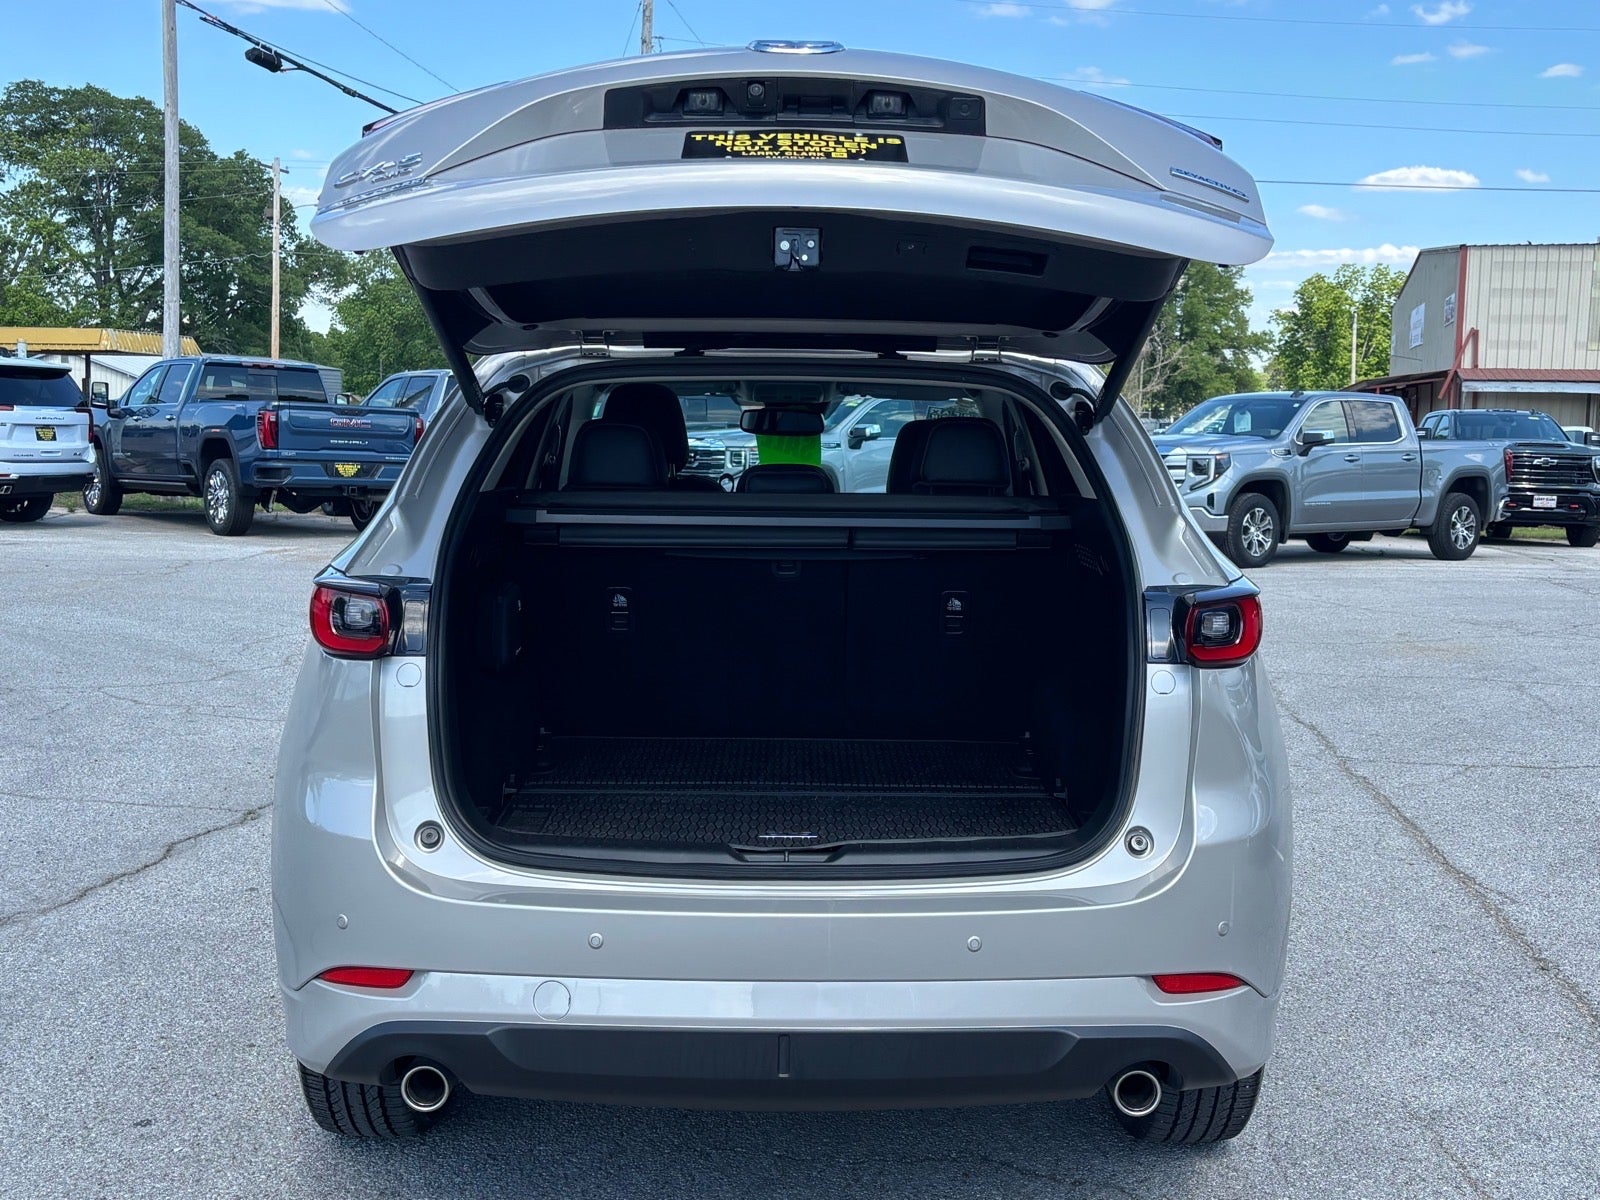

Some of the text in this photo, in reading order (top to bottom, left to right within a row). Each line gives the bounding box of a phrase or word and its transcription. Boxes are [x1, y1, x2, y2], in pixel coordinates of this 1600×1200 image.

[759, 133, 869, 143] VEHICLE
[877, 137, 902, 145] IS
[776, 140, 878, 150] STOLEN
[778, 146, 867, 155] ALMOST)
[330, 417, 371, 428] GMC
